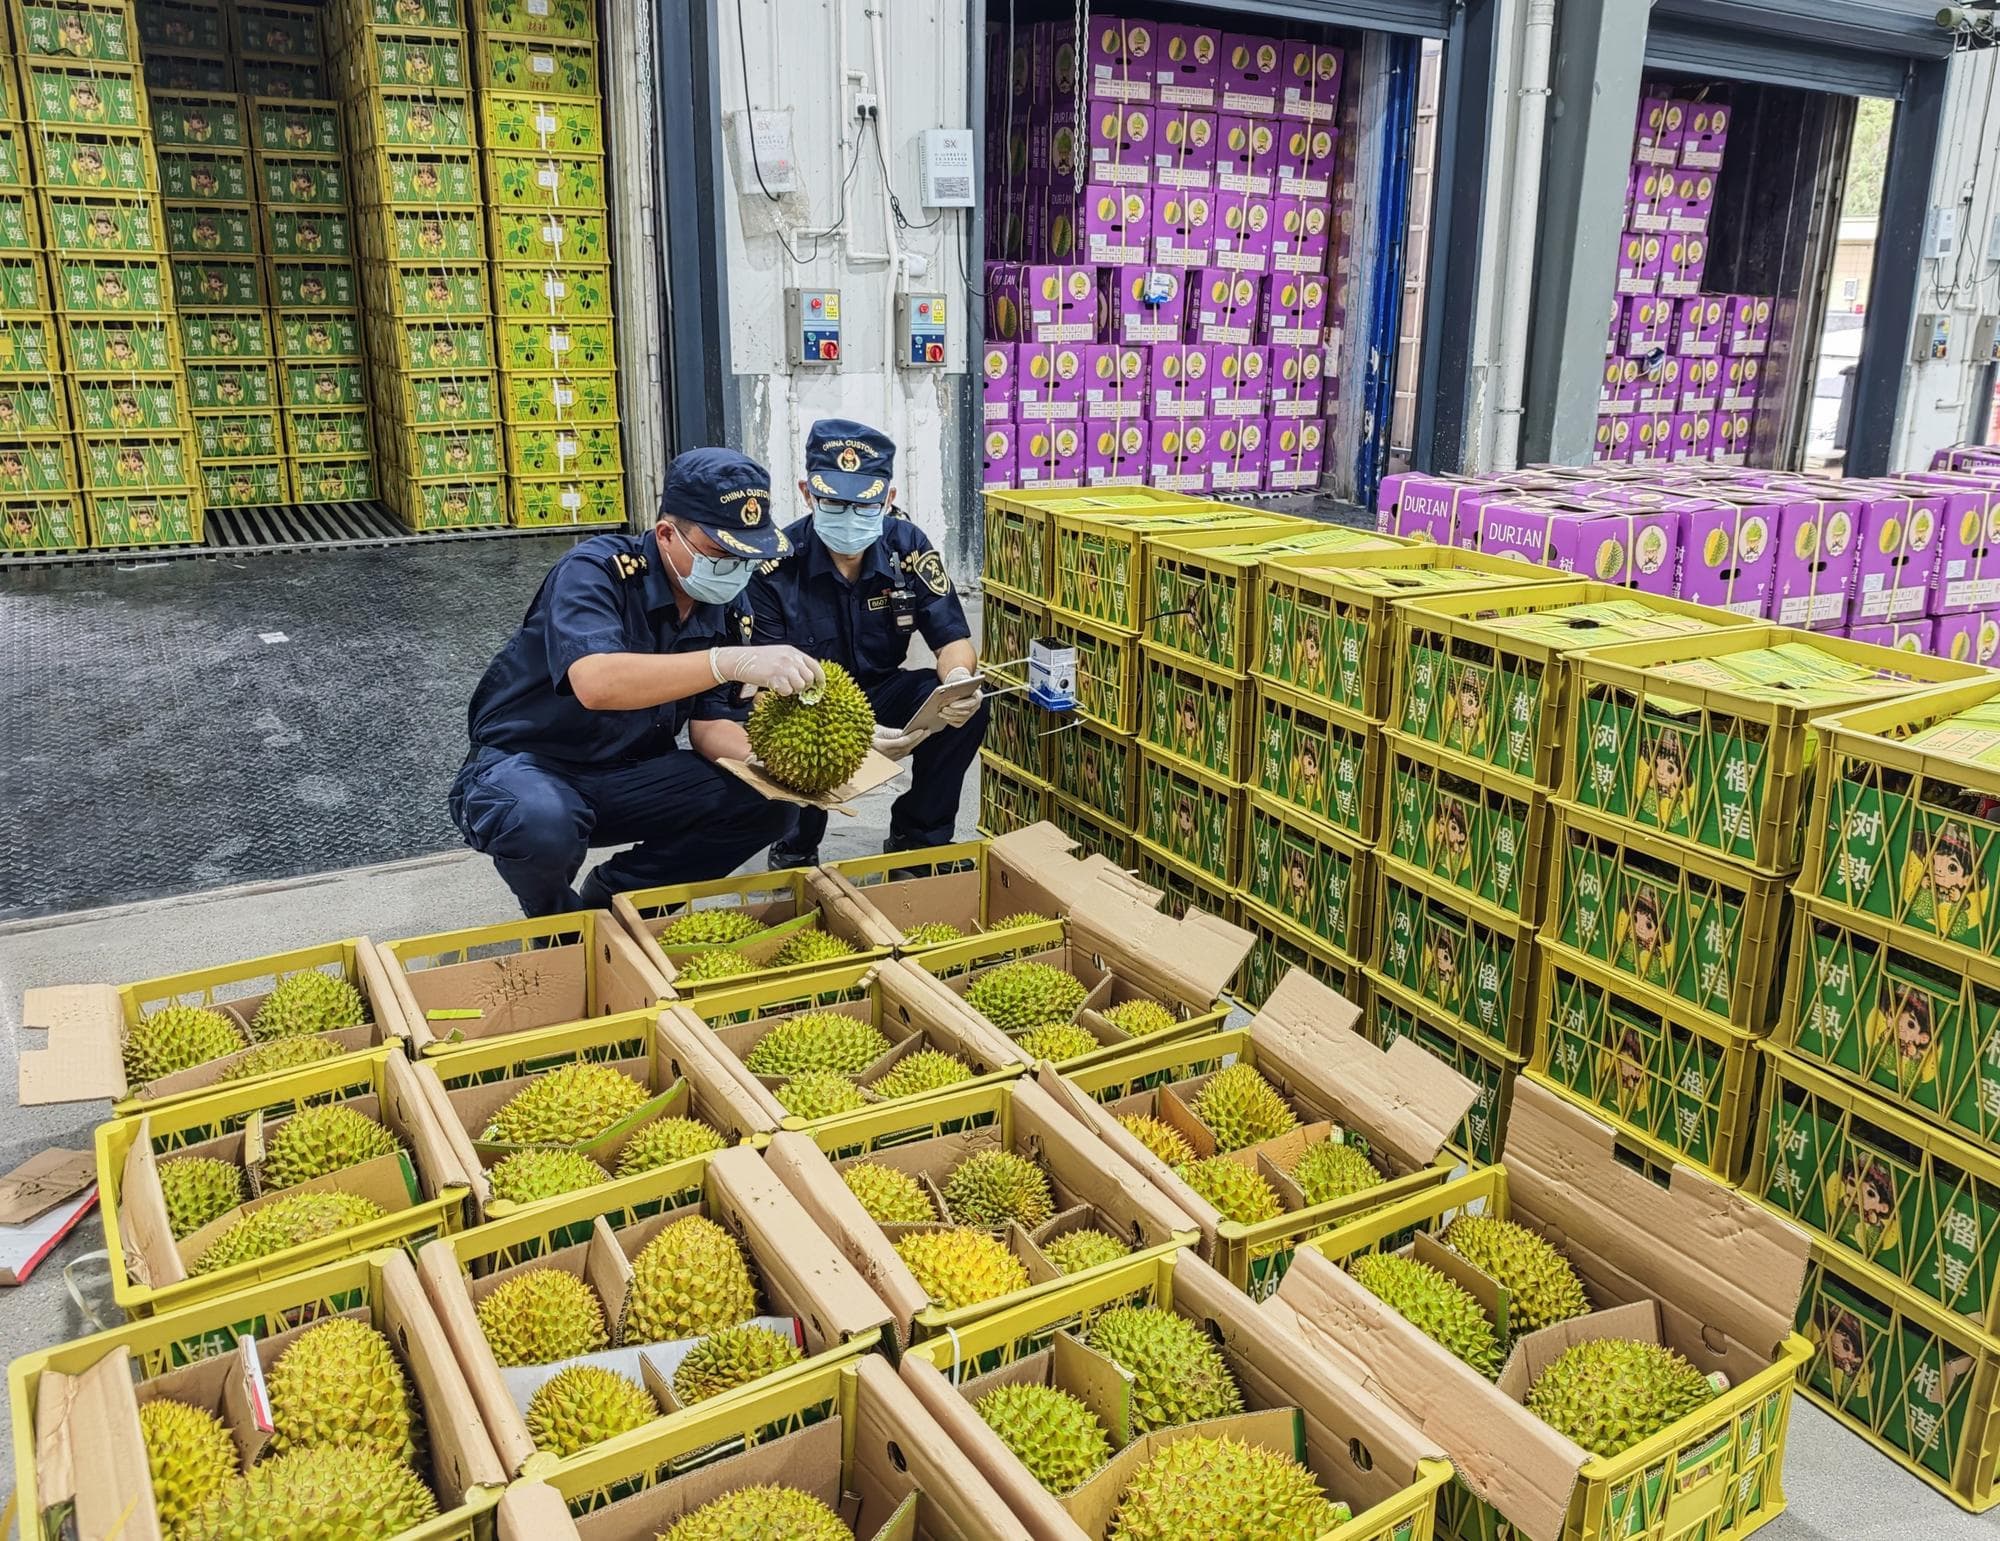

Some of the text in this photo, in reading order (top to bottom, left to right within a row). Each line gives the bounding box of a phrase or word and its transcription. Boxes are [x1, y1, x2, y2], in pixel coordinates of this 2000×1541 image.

[943, 137, 959, 149] SX
[823, 439, 879, 458] CHINA CUSTOMS
[720, 490, 746, 504] CHINA
[1404, 495, 1448, 518] DURIAN
[1488, 522, 1542, 549] DURIAN
[1590, 722, 1617, 795] 树熟
[1722, 757, 1757, 840] 榴莲
[1836, 804, 1882, 893] 树熟
[1575, 868, 1600, 941] 树熟
[1701, 919, 1733, 999] 榴莲
[1809, 955, 1850, 1041] 树熟
[1555, 1002, 1584, 1073] 树熟
[1675, 1066, 1709, 1144] 榴莲
[1774, 1120, 1809, 1200] 树熟
[1932, 1206, 1977, 1297] 榴莲
